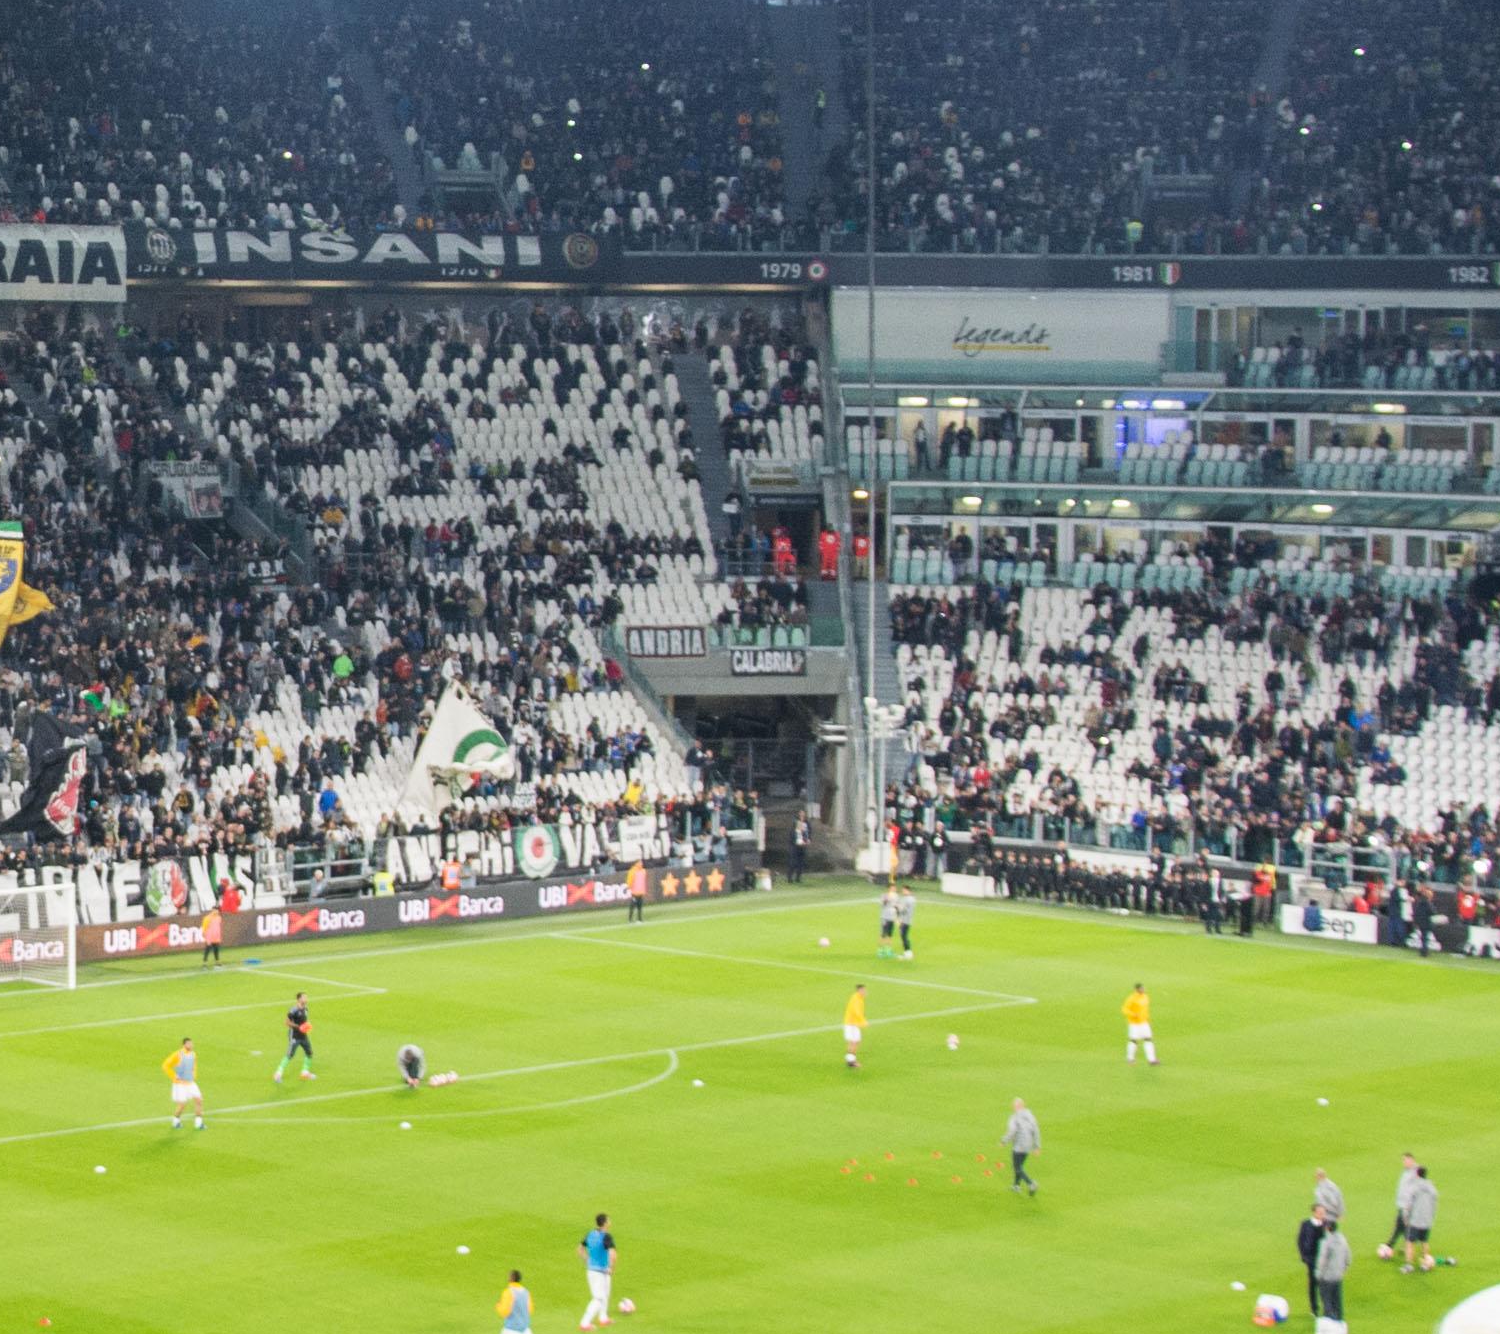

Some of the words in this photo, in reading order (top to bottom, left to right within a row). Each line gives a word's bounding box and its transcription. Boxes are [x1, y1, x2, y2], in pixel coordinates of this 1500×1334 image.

[194, 231, 542, 264] INSANI
[759, 263, 801, 280] 1979
[1112, 264, 1154, 282] 1981
[1448, 265, 1489, 283] 1982
[629, 628, 706, 656] ANDRIA
[732, 649, 794, 674] CALABRIA
[400, 898, 430, 923] UBI
[458, 894, 504, 915] Banca
[538, 886, 567, 908] UBI
[257, 913, 288, 938] UBI
[315, 908, 367, 933] Banca
[12, 939, 65, 963] Banca
[104, 929, 136, 954] UBI
